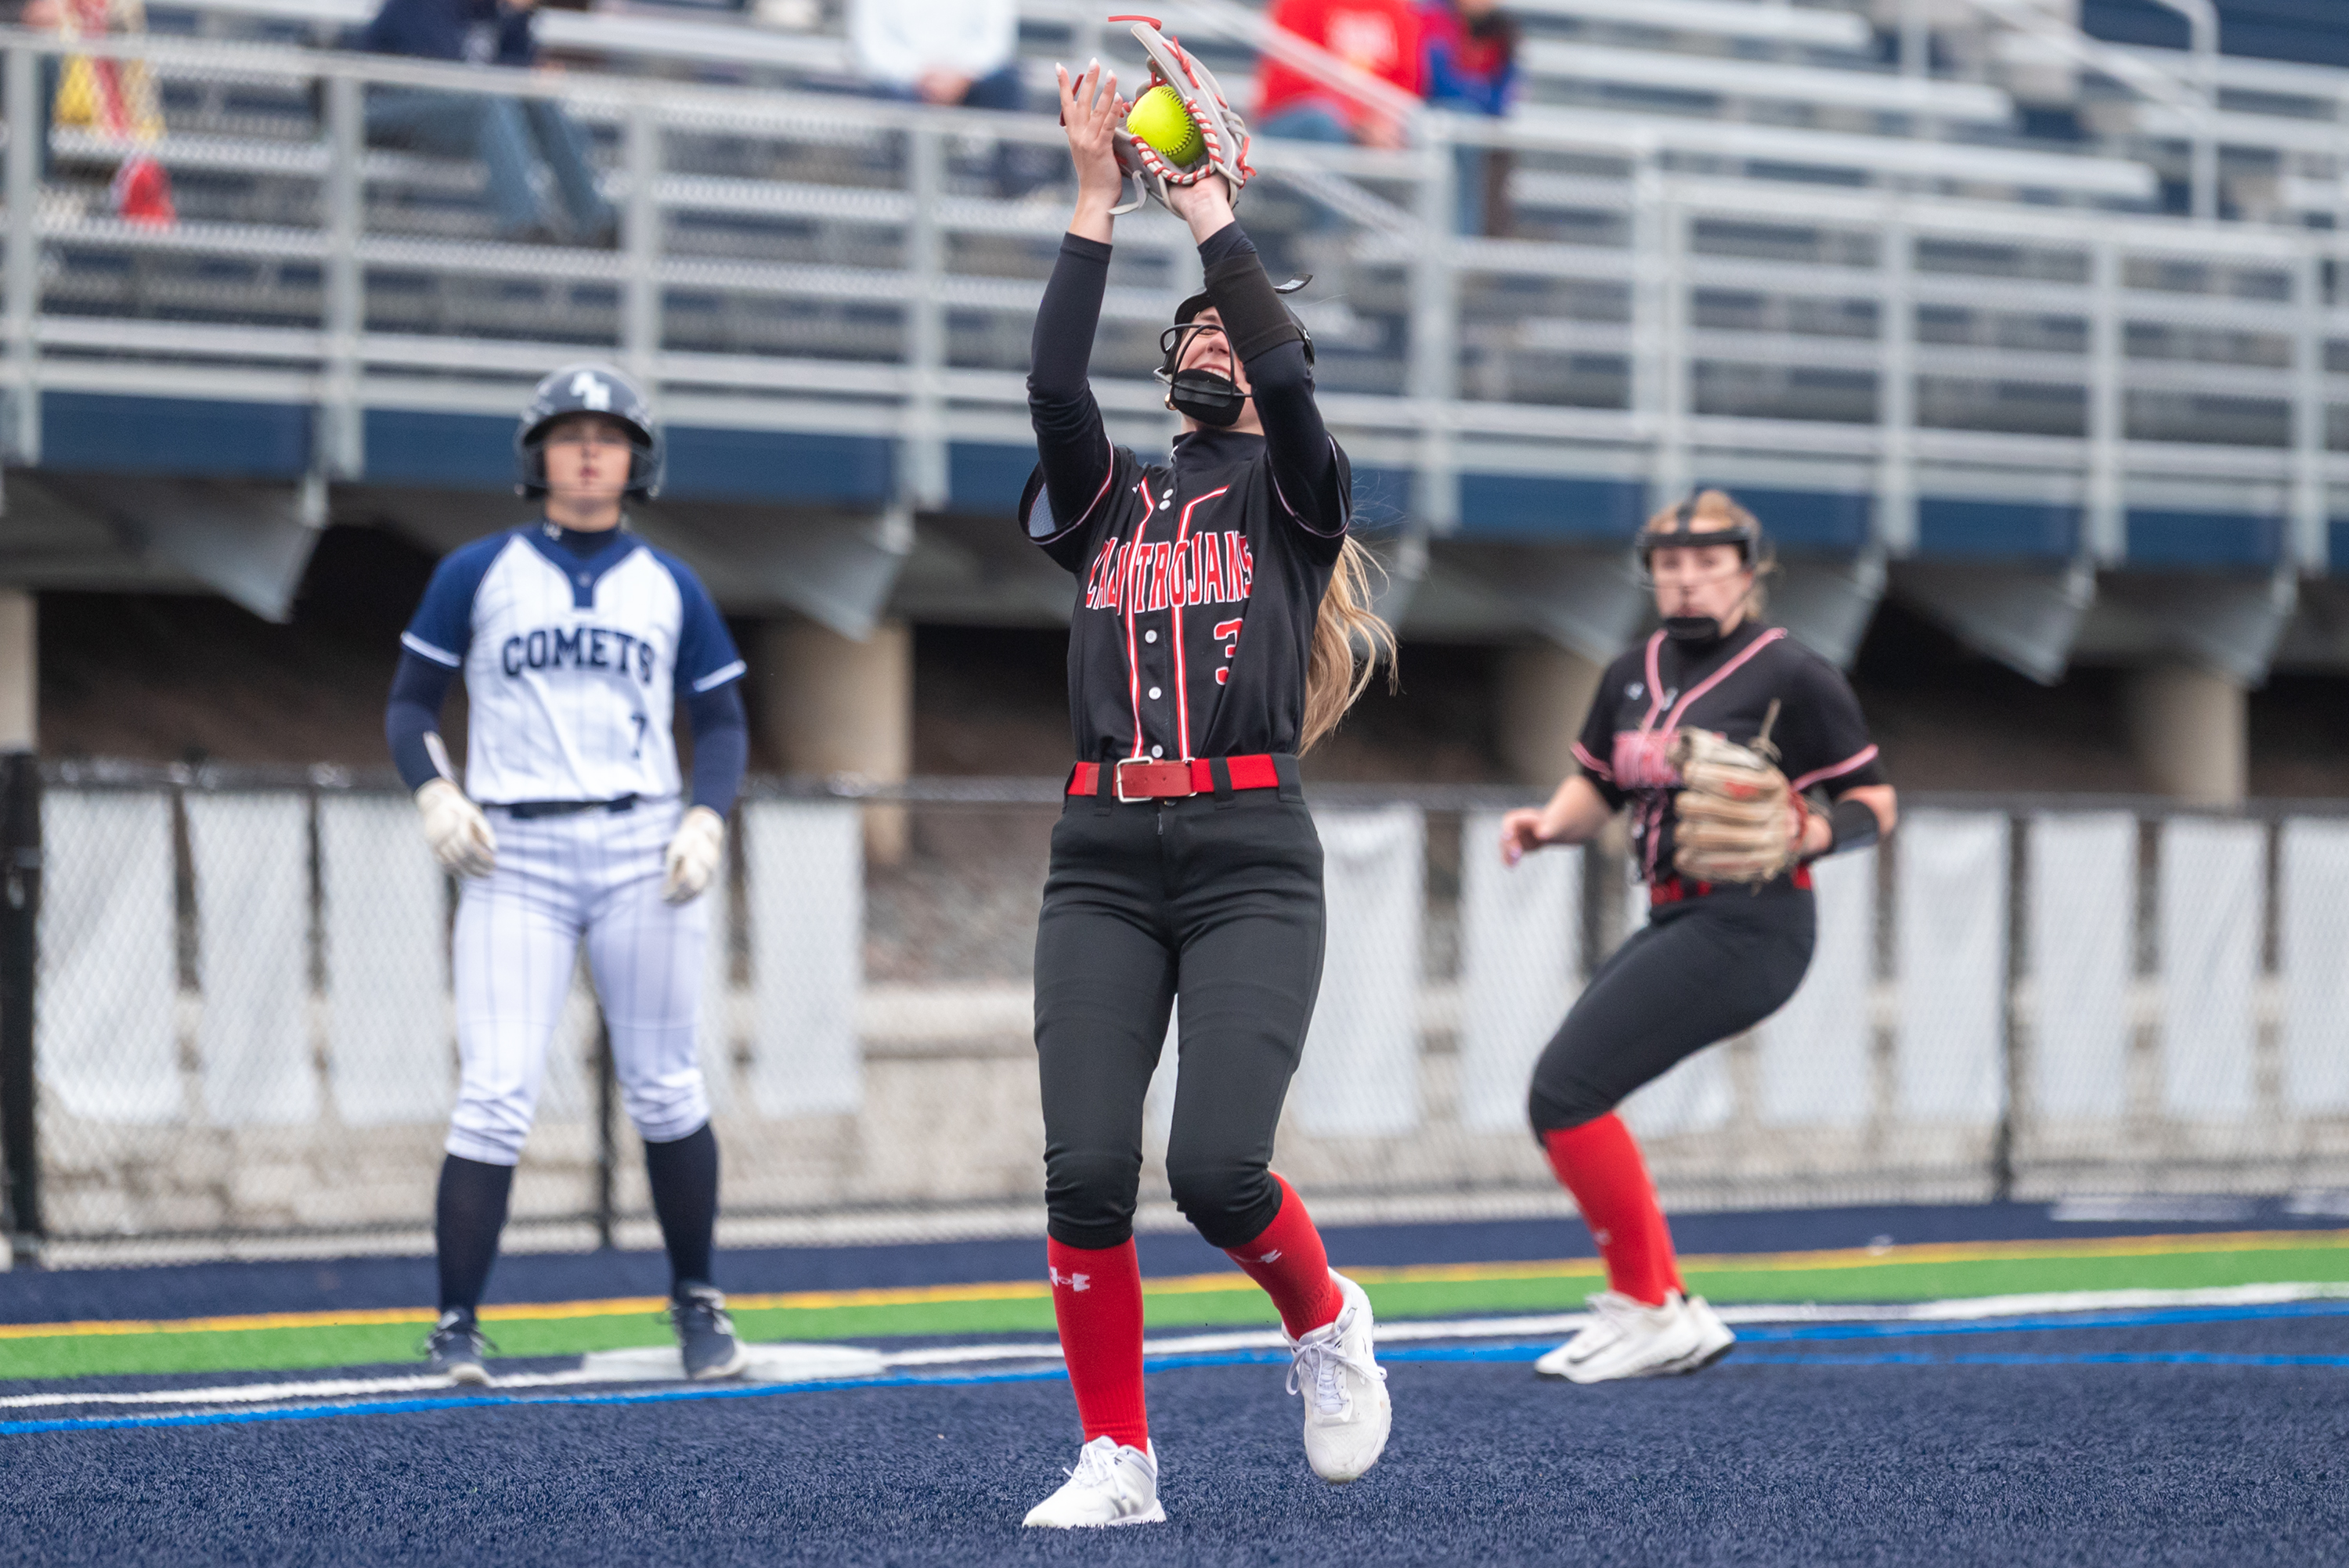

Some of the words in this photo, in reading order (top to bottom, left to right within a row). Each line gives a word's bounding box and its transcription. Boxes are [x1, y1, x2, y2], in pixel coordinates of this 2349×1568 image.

[1134, 530, 1254, 614] TROJANS
[502, 626, 656, 685] COMETS
[1212, 618, 1243, 686] 3
[629, 712, 648, 759] 7
